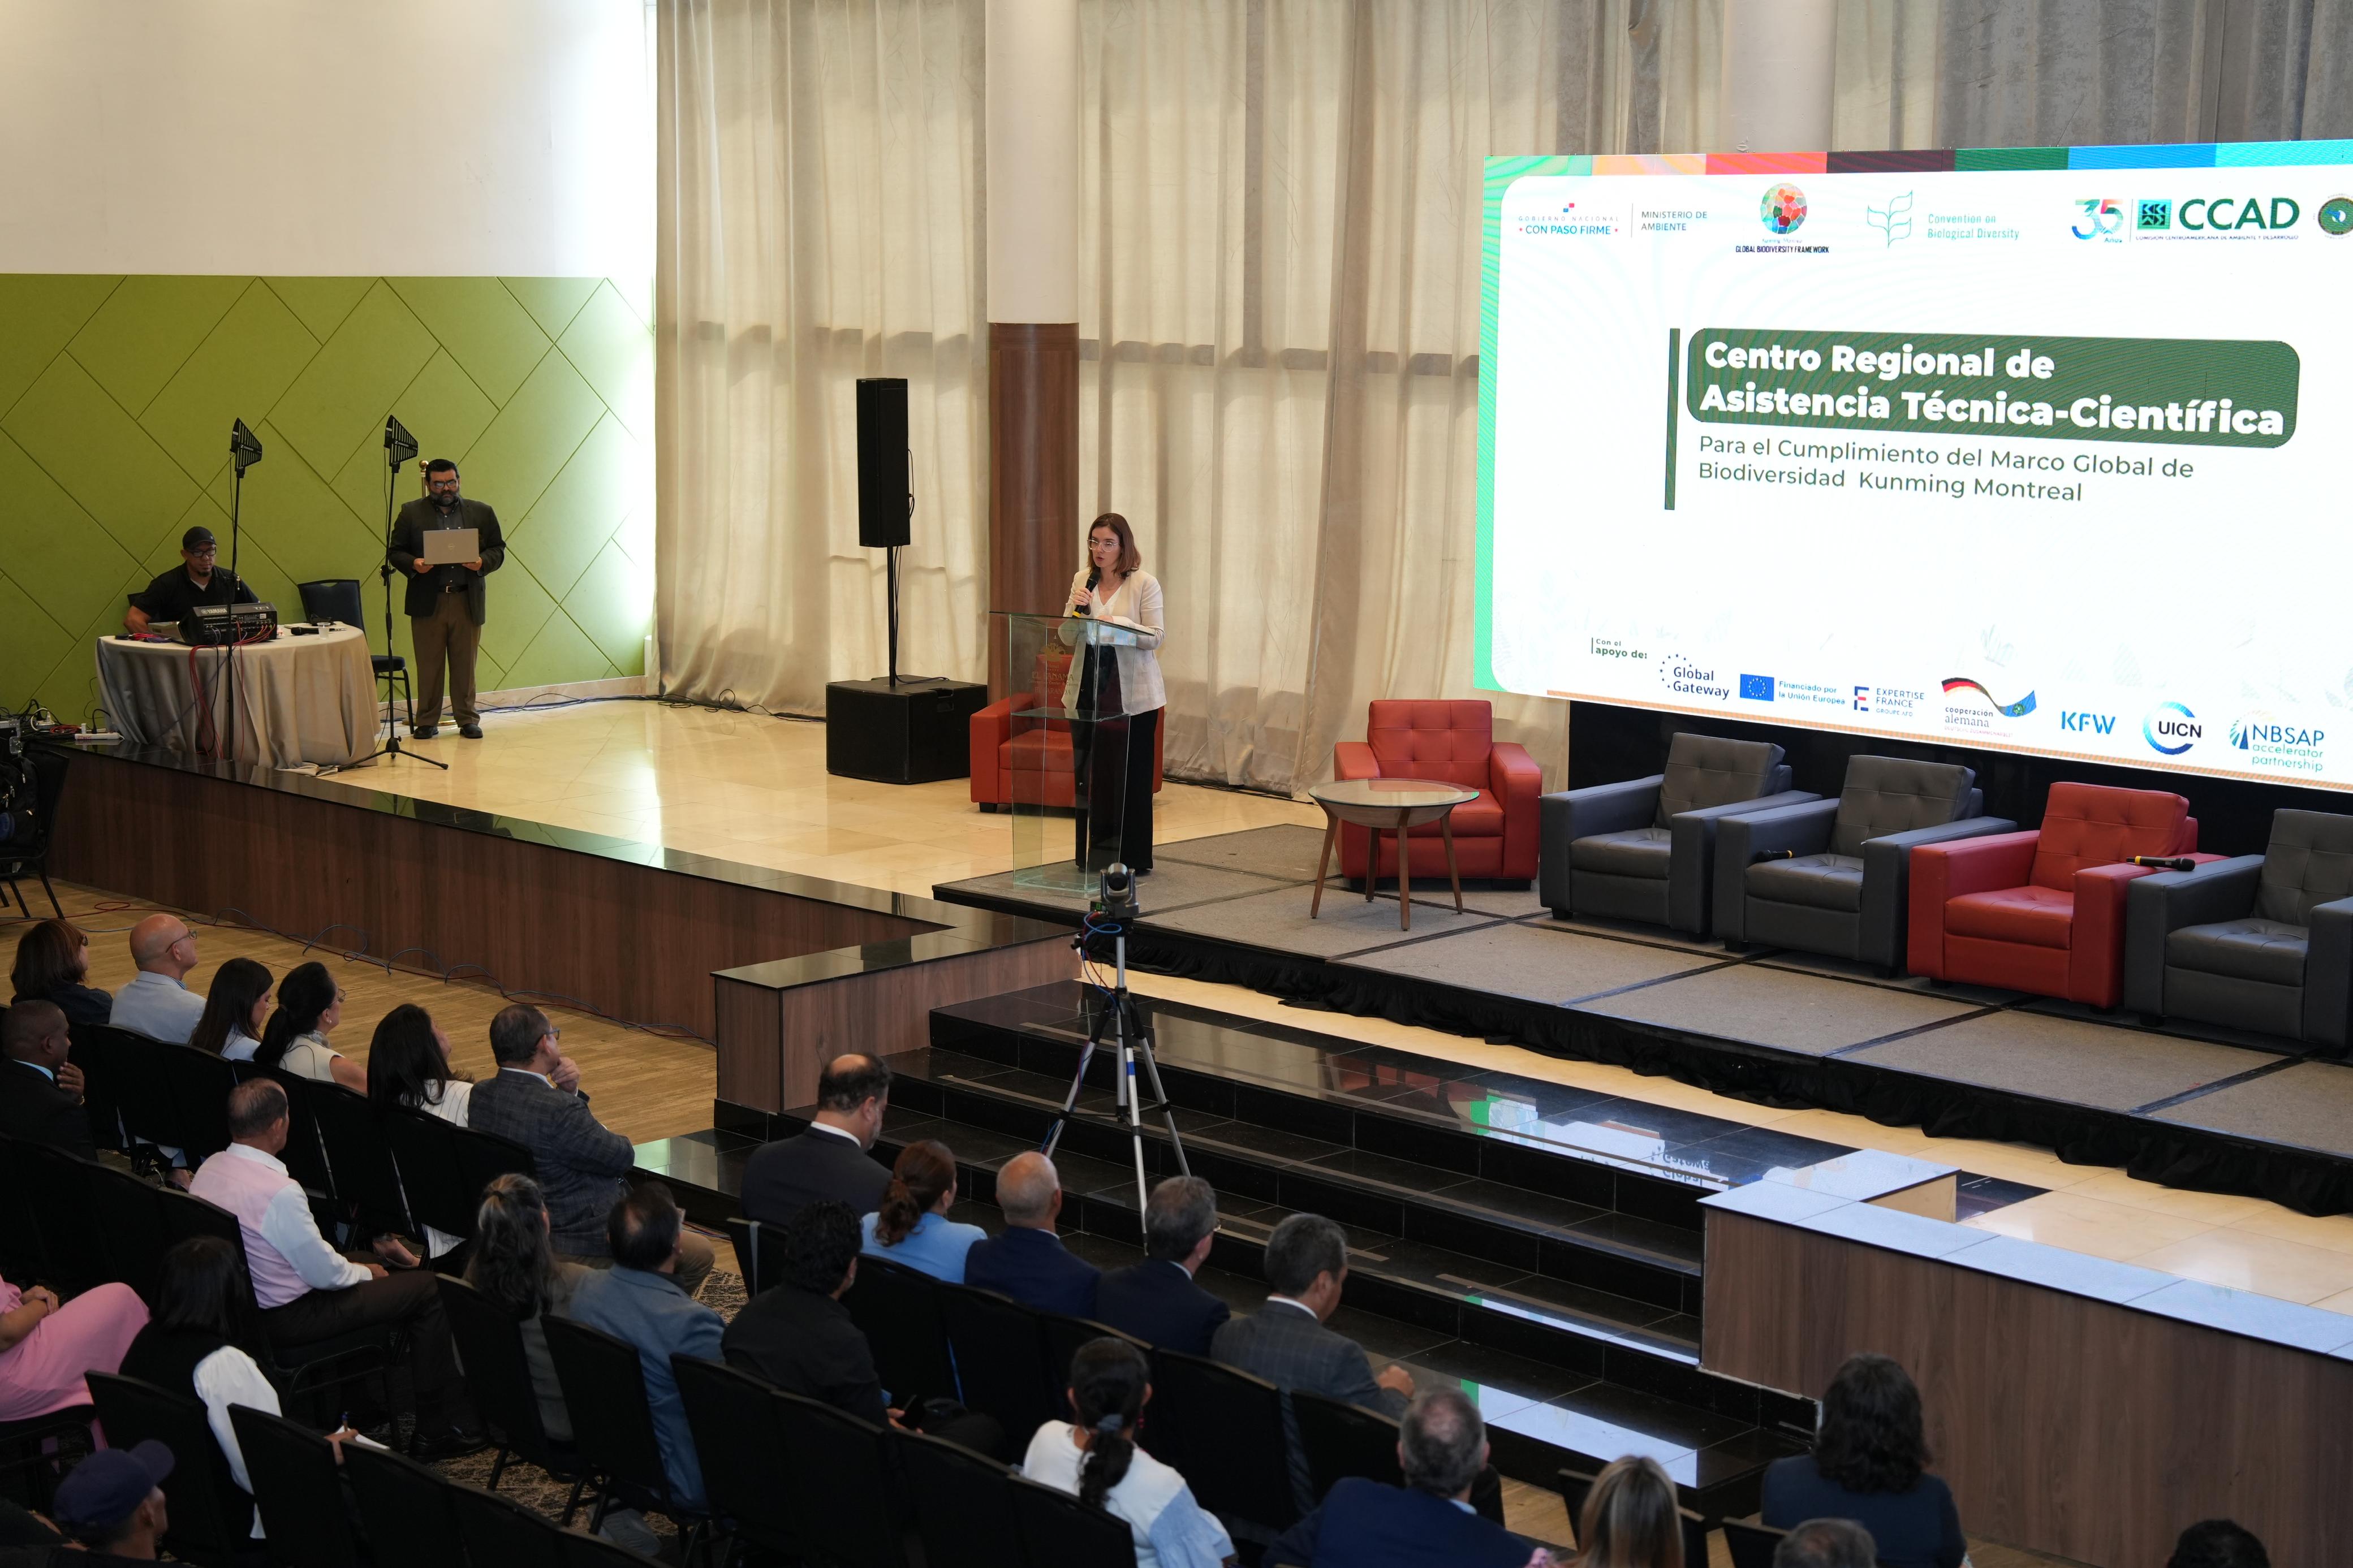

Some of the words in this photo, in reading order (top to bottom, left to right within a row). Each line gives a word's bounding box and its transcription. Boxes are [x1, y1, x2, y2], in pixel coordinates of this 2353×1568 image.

[1929, 214, 1981, 223] Convention
[2179, 197, 2300, 230] CCAD
[1525, 224, 1548, 234] CON
[1550, 226, 1578, 234] PASO
[1580, 226, 1610, 235] FIRME
[1928, 228, 1974, 240] Biological
[1977, 228, 2019, 240] Diversity
[1705, 342, 1821, 372] Centro
[1832, 344, 1994, 380] Regional
[2006, 348, 2055, 379] de
[1700, 381, 1890, 419] Asistencia
[1902, 390, 2283, 435] Técnica-Científica
[1700, 436, 1745, 453] Para
[1753, 438, 1770, 455] el
[1778, 440, 1938, 464] Cumplimiento
[1947, 448, 1981, 466] del
[1992, 451, 2065, 471] Marco
[2074, 455, 2152, 476] Global
[2162, 459, 2193, 478] de
[1700, 461, 1845, 487] Biodiversidad
[1860, 472, 1964, 498] Kunming
[1975, 478, 2081, 501] Montreal
[1595, 647, 1628, 658] apoyo
[1631, 650, 1647, 659] de:
[1673, 667, 1714, 681] Global
[1673, 681, 1730, 700] Gateway
[1779, 680, 1822, 693] Financiado
[1787, 692, 1811, 701] Unión
[1813, 695, 1846, 705] Europea
[1876, 688, 1925, 701] EXPERTISE
[1876, 696, 1914, 709] FRANCE
[1945, 707, 1993, 718] cooperación
[1945, 714, 1990, 728] alemana
[2158, 721, 2201, 738] UICN
[2252, 723, 2324, 747] NBSAP
[2252, 743, 2324, 758] accelerator
[2252, 755, 2324, 772] partnership
